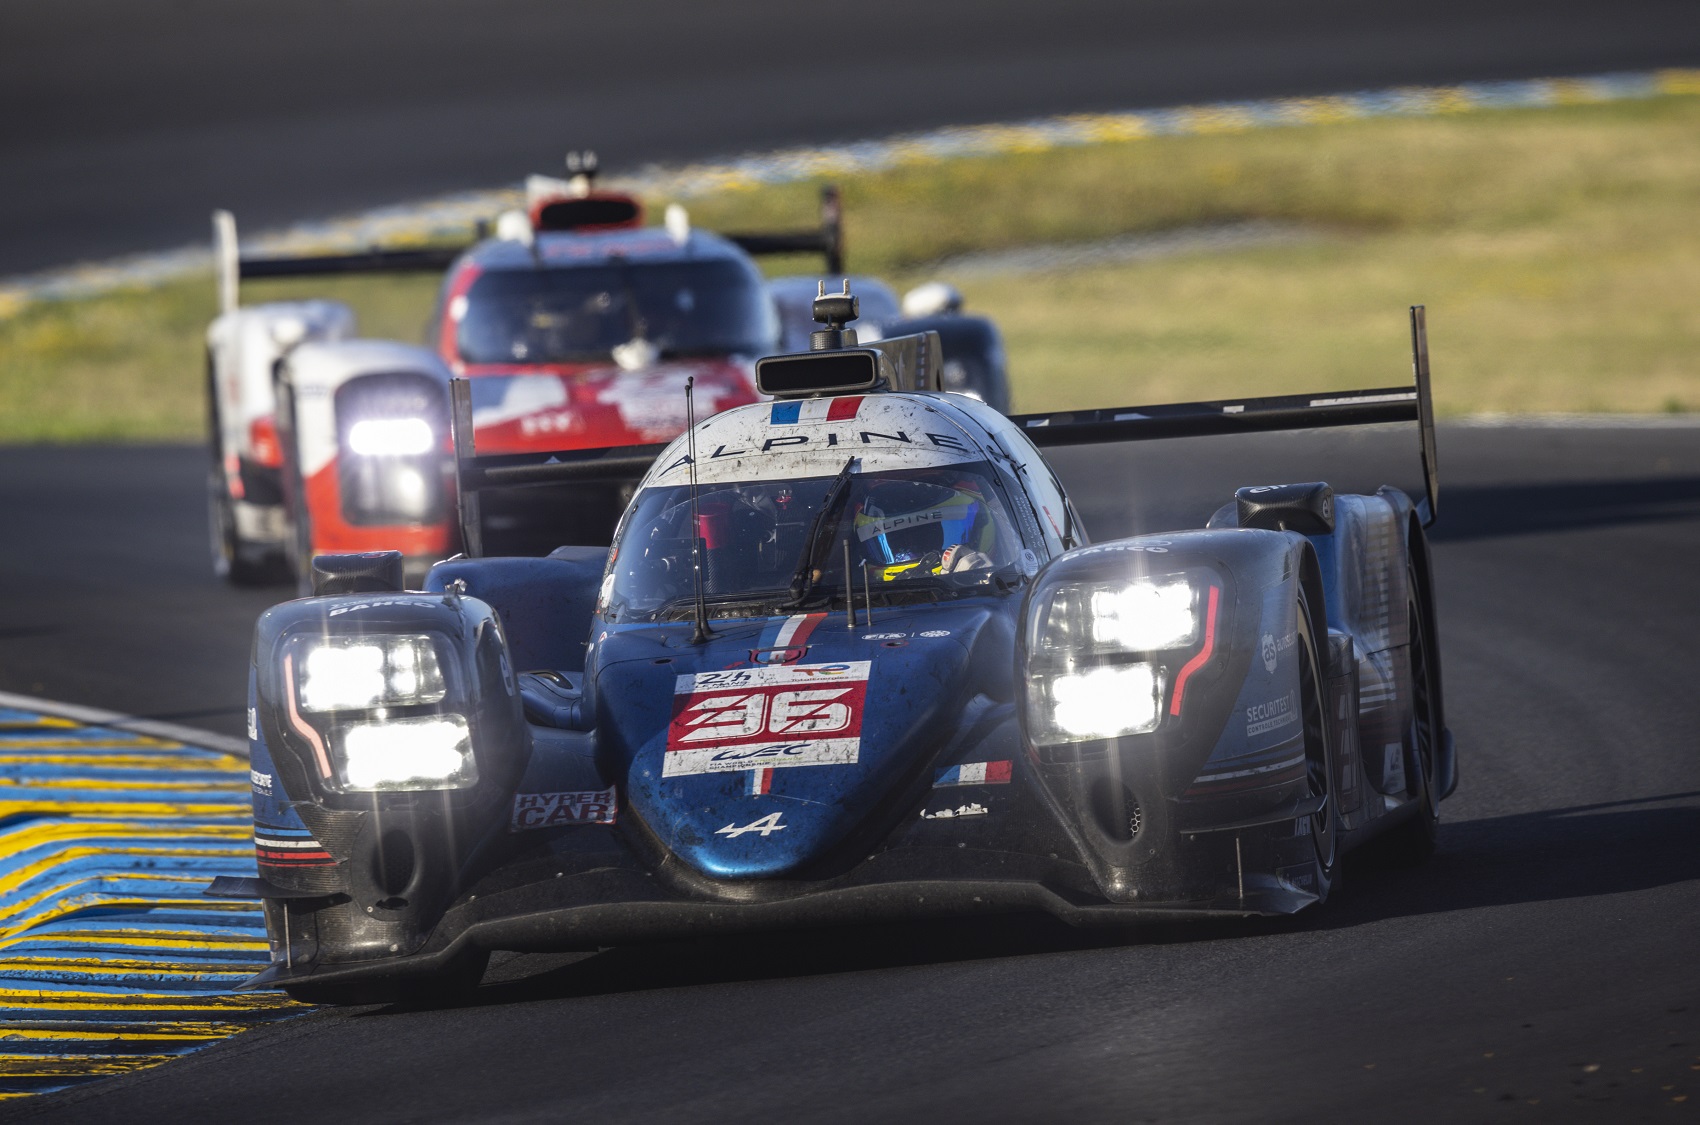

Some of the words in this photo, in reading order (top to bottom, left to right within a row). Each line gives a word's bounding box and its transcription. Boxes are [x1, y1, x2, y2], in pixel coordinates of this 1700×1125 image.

[658, 431, 964, 477] ALPINE
[872, 511, 943, 534] ALPINE
[1062, 546, 1169, 562] BAHCO
[329, 601, 436, 616] BAHCO
[1264, 643, 1276, 662] as
[677, 687, 854, 744] 36
[1247, 695, 1289, 722] SECURITEST
[711, 744, 811, 761] WEC
[519, 792, 611, 808] HYPER
[517, 803, 609, 826] CAR
